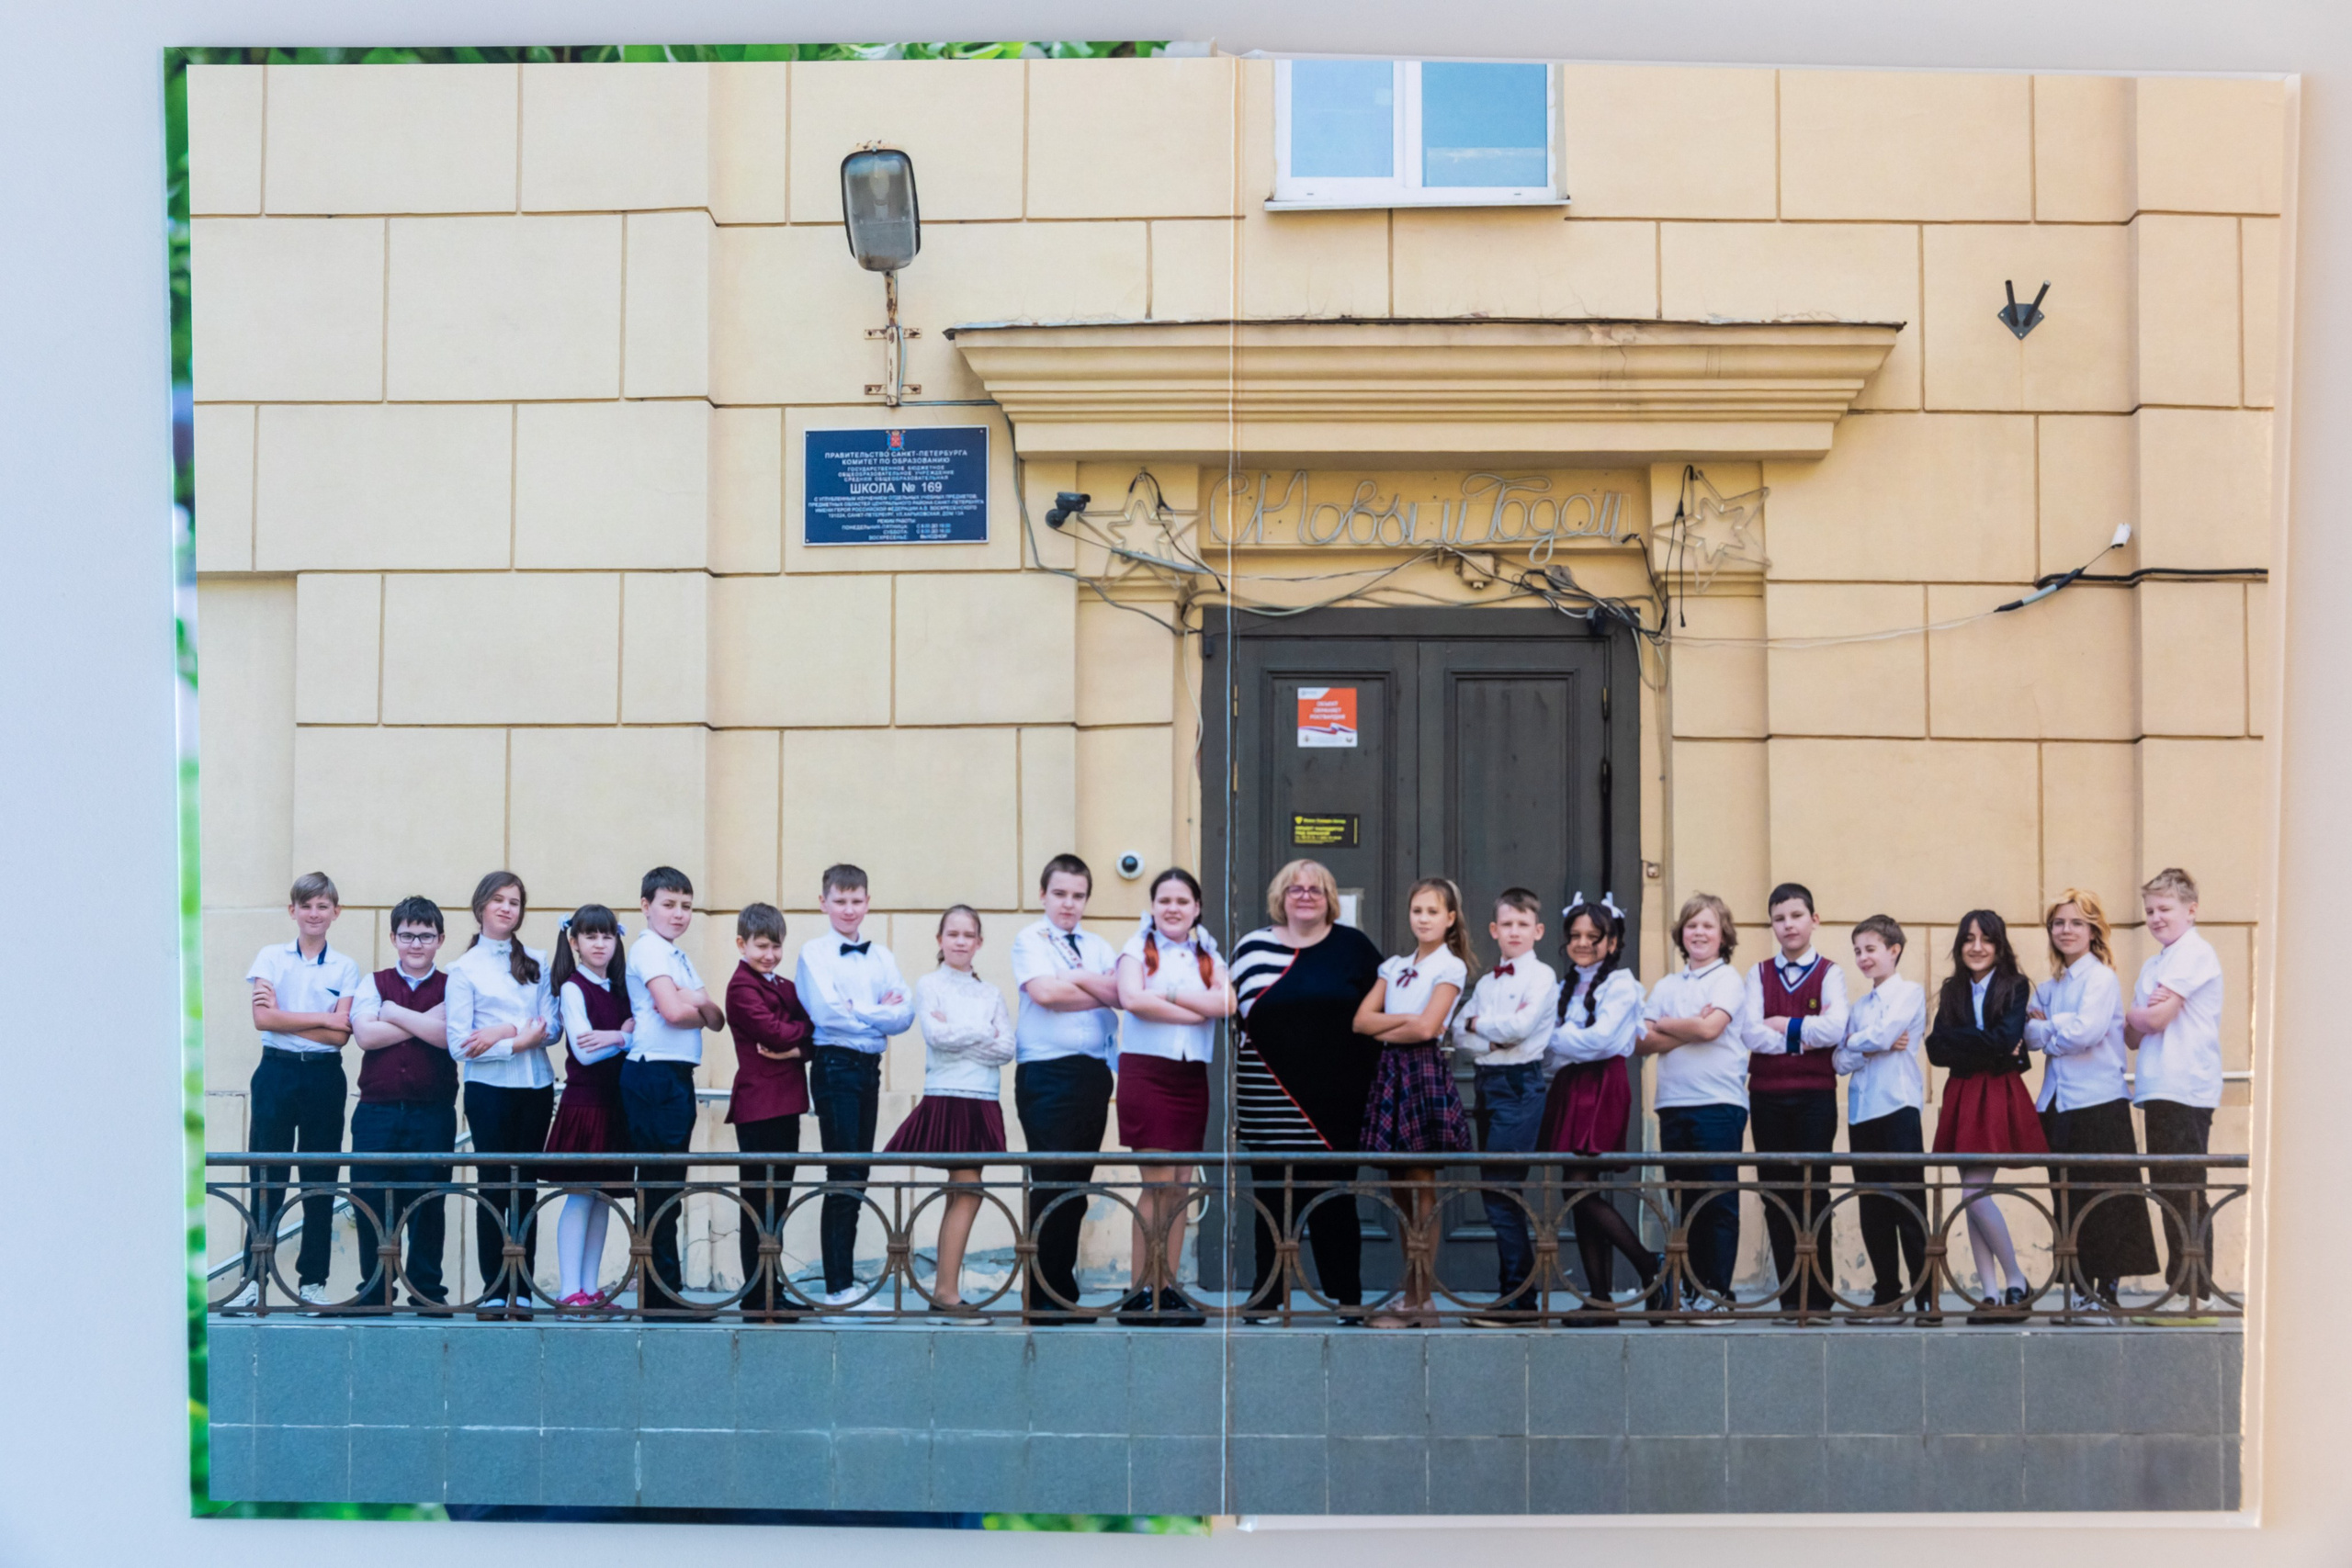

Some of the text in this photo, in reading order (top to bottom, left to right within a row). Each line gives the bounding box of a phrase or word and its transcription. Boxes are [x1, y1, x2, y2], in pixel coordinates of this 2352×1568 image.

[825, 449, 967, 459] ПРАВИТЕЛЬСТВО САНКТ-ПЕТЕРБУРГА
[850, 481, 943, 494] ШКОЛА № 169
